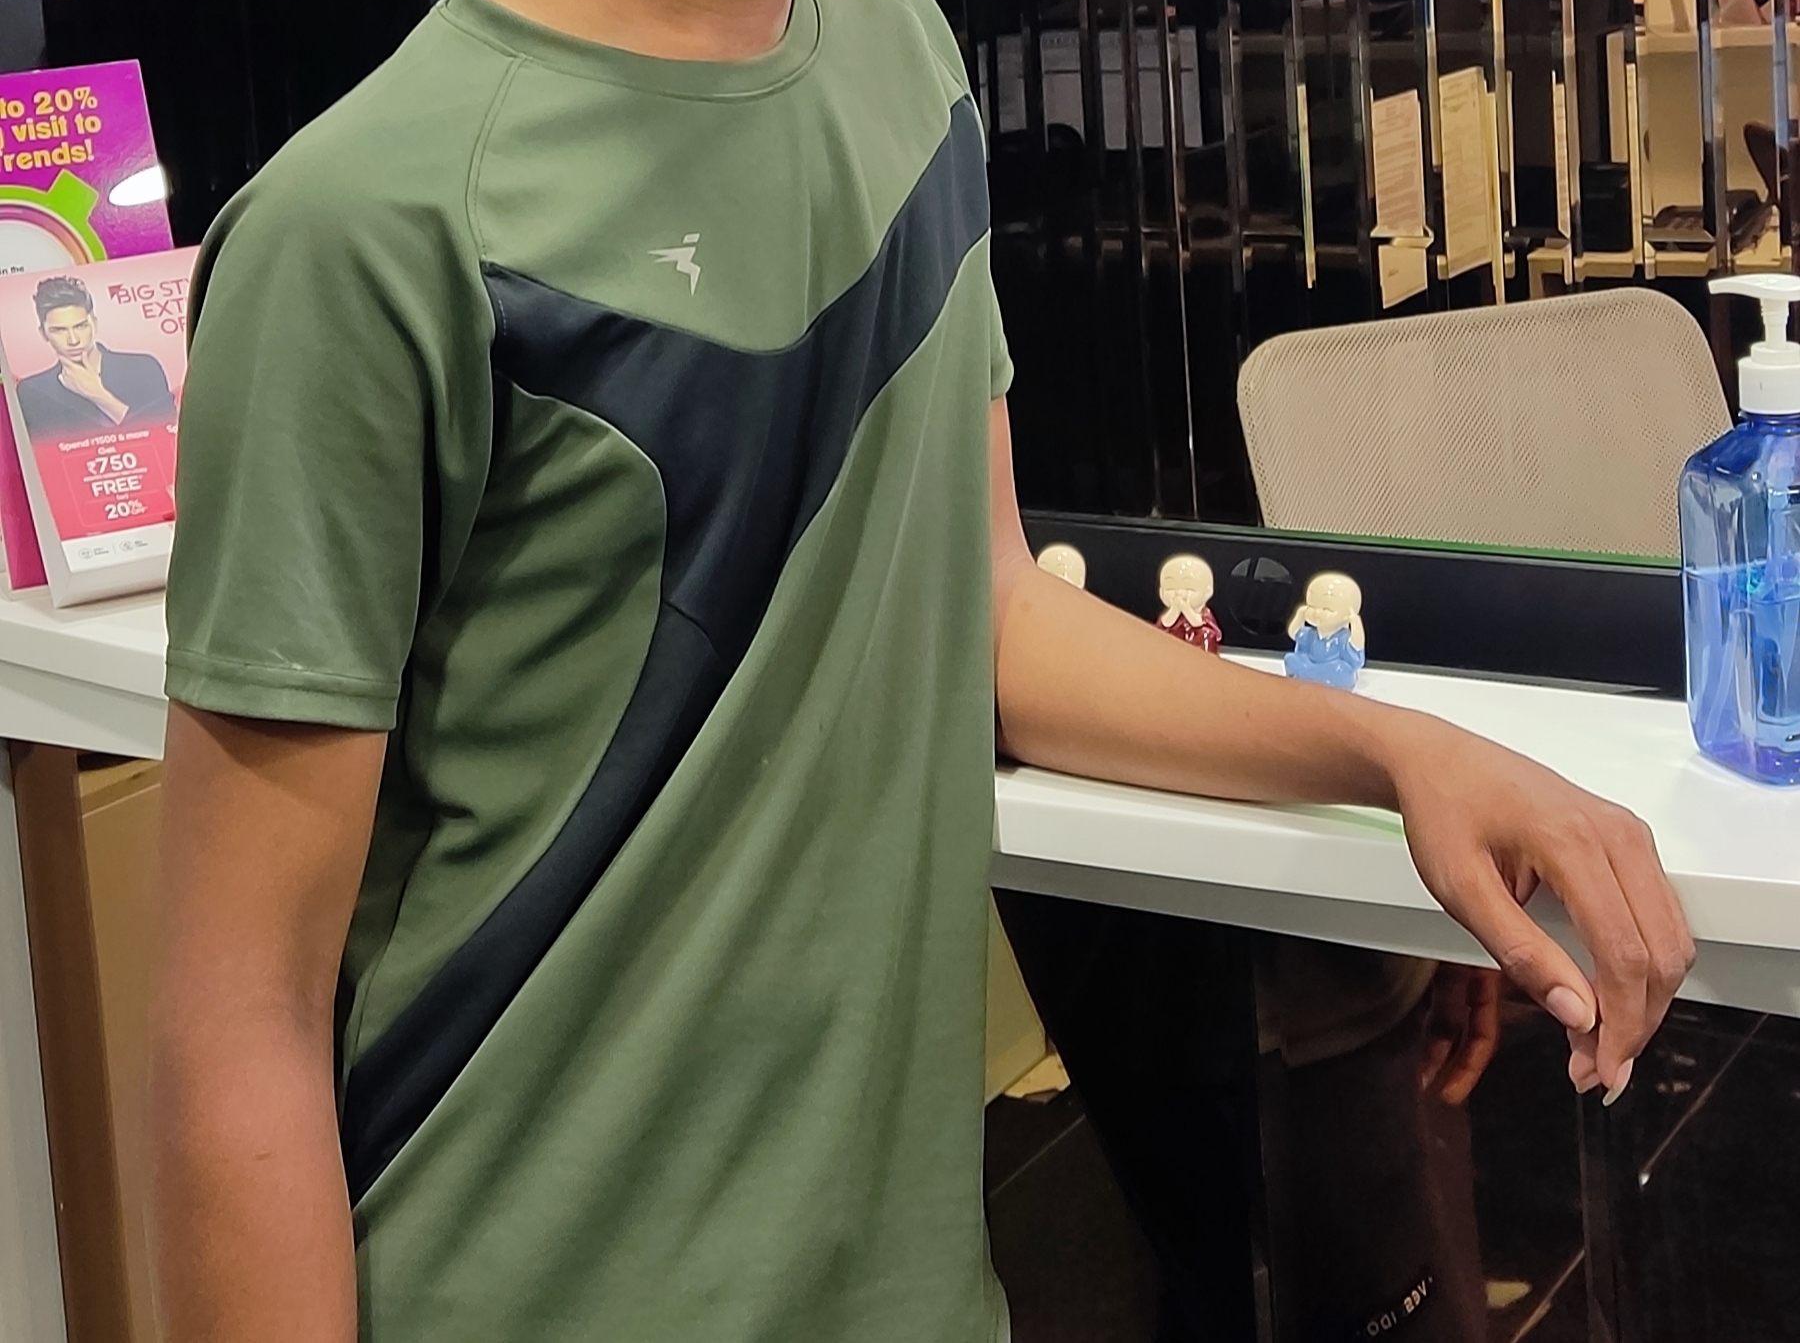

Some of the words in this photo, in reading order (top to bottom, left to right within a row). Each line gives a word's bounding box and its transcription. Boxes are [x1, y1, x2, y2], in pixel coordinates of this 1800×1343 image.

[33, 86, 98, 115] 20%
[11, 115, 68, 143] visit
[75, 113, 102, 134] to
[0, 139, 95, 172] rends!
[116, 284, 155, 305] BIG
[159, 278, 189, 298] ST
[58, 438, 90, 453] Spend
